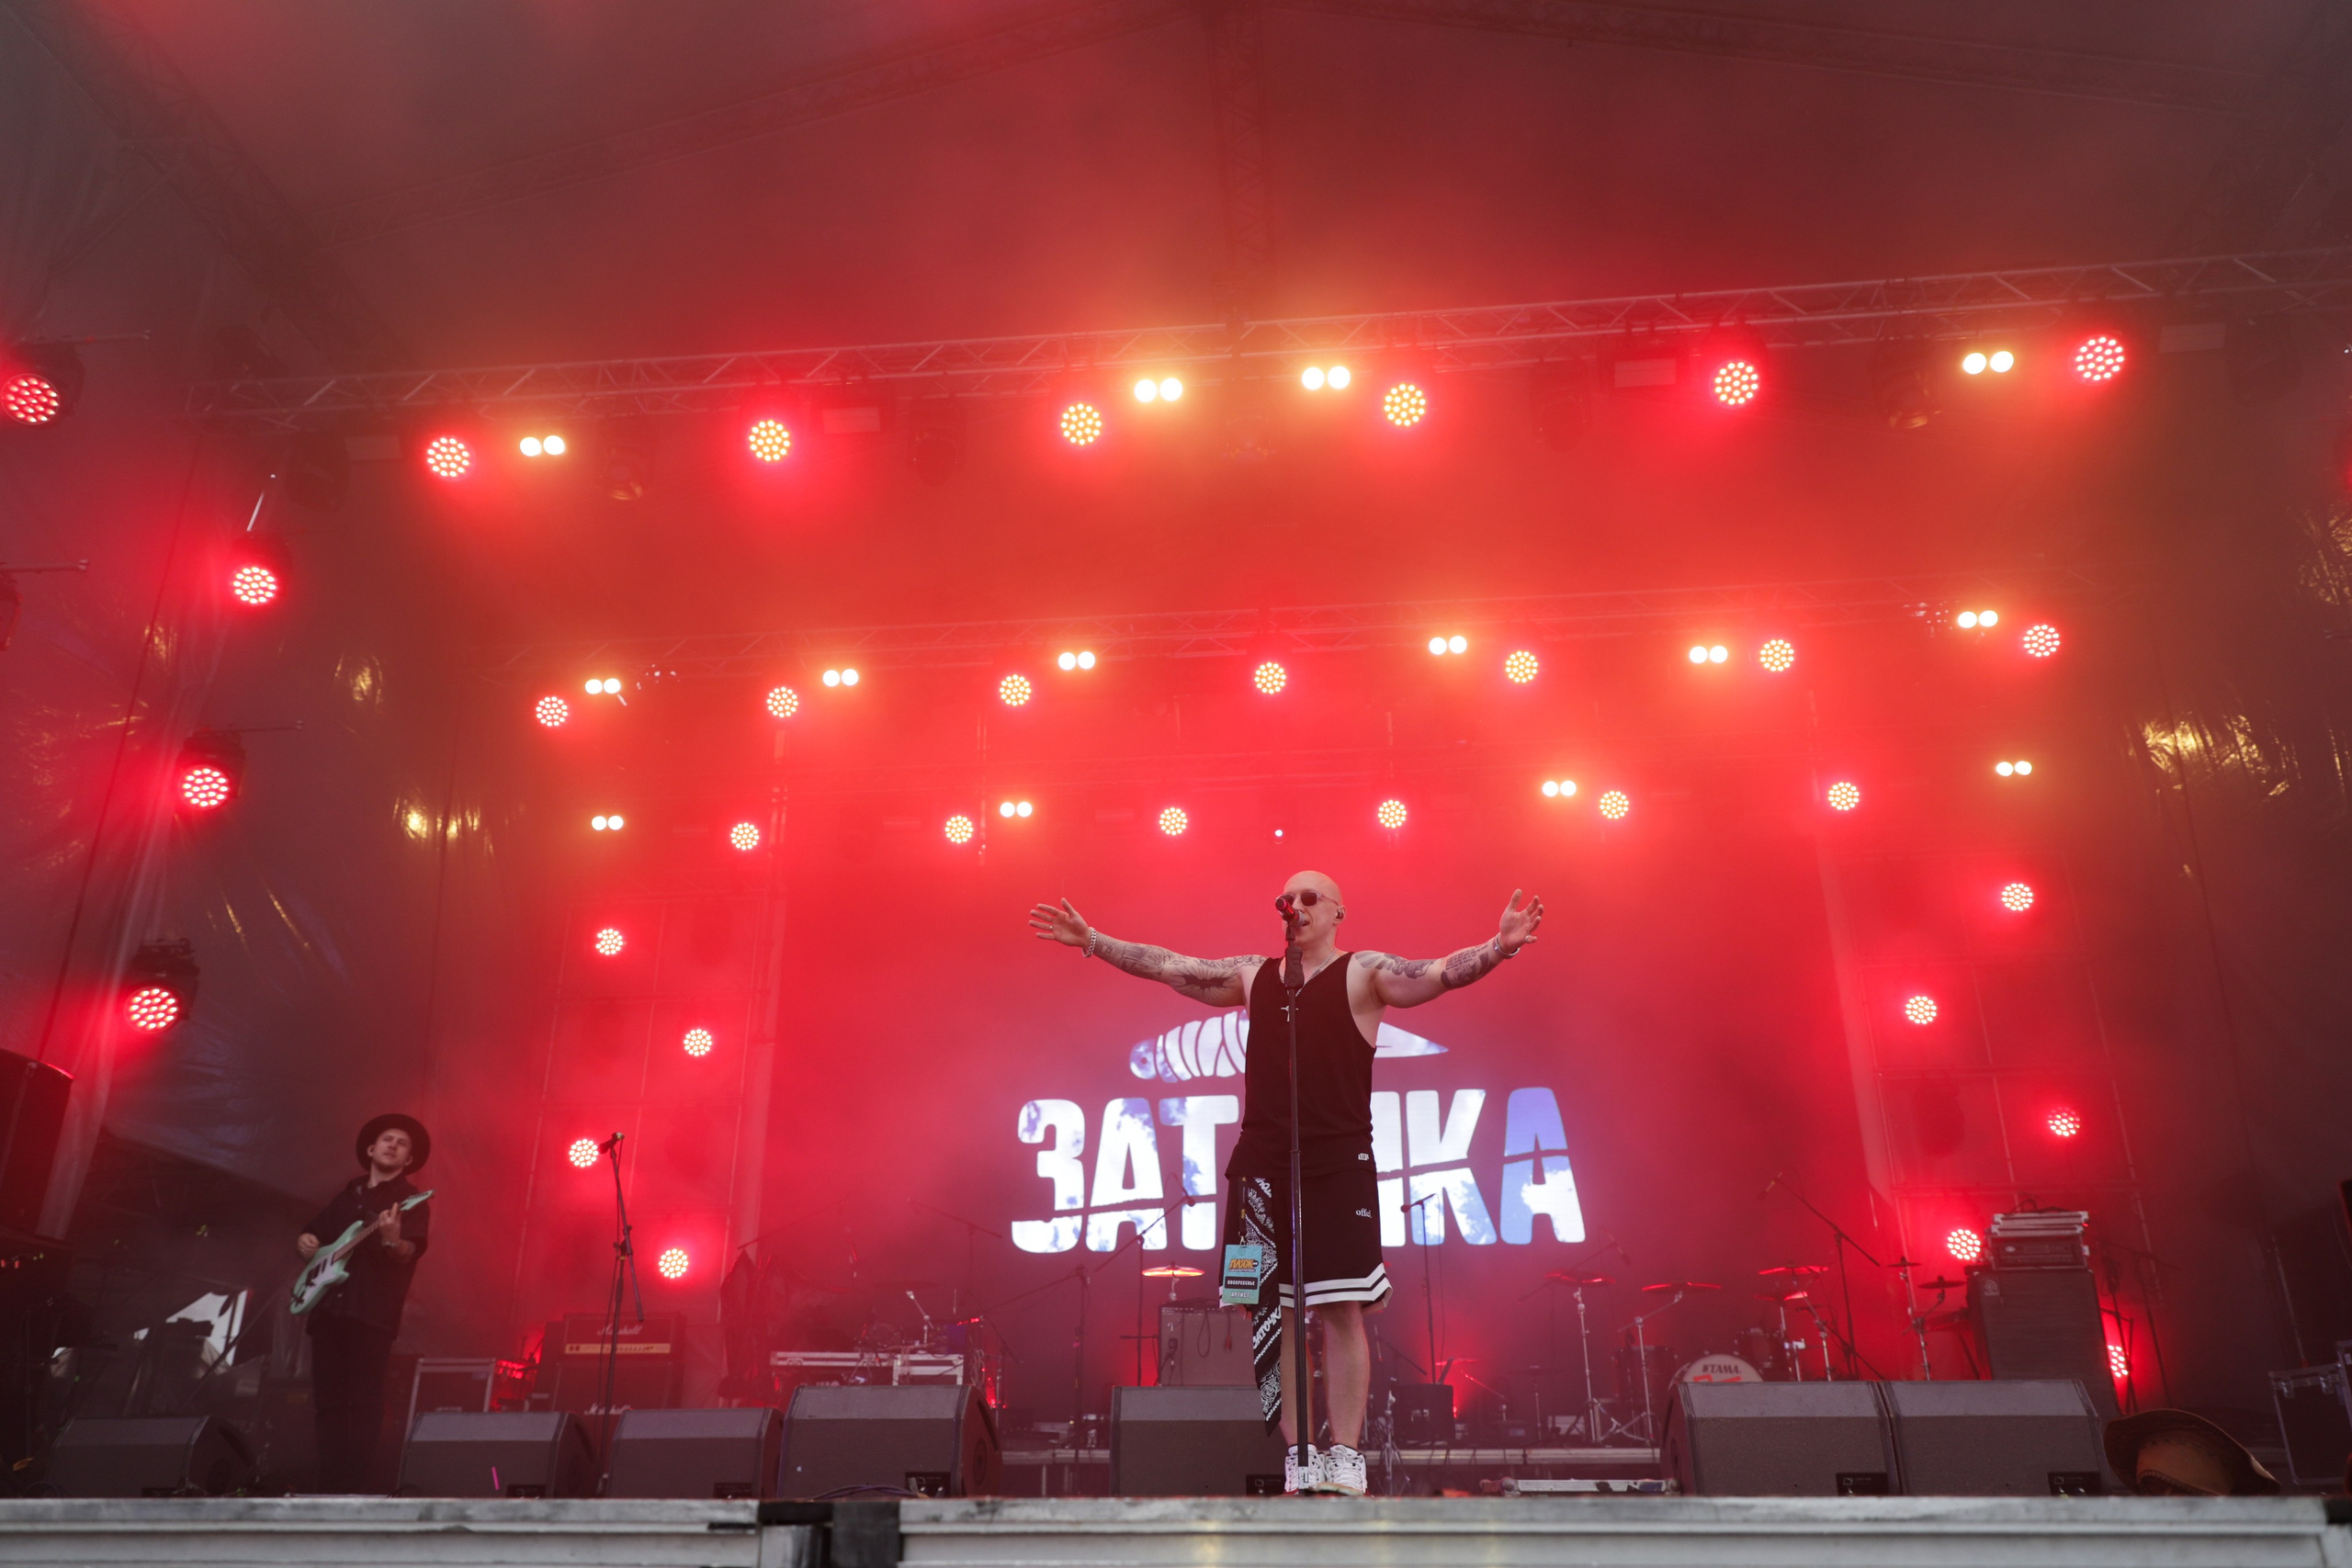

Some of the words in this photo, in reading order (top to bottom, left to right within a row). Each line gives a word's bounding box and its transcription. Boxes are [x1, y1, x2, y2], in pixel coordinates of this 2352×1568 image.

[1012, 1088, 1586, 1253] ЗАТКА
[1228, 1258, 1254, 1269] ПЛЯЖ
[1252, 1304, 1282, 1350] ЗАТОЧК
[1710, 1363, 1739, 1375] TAMA
